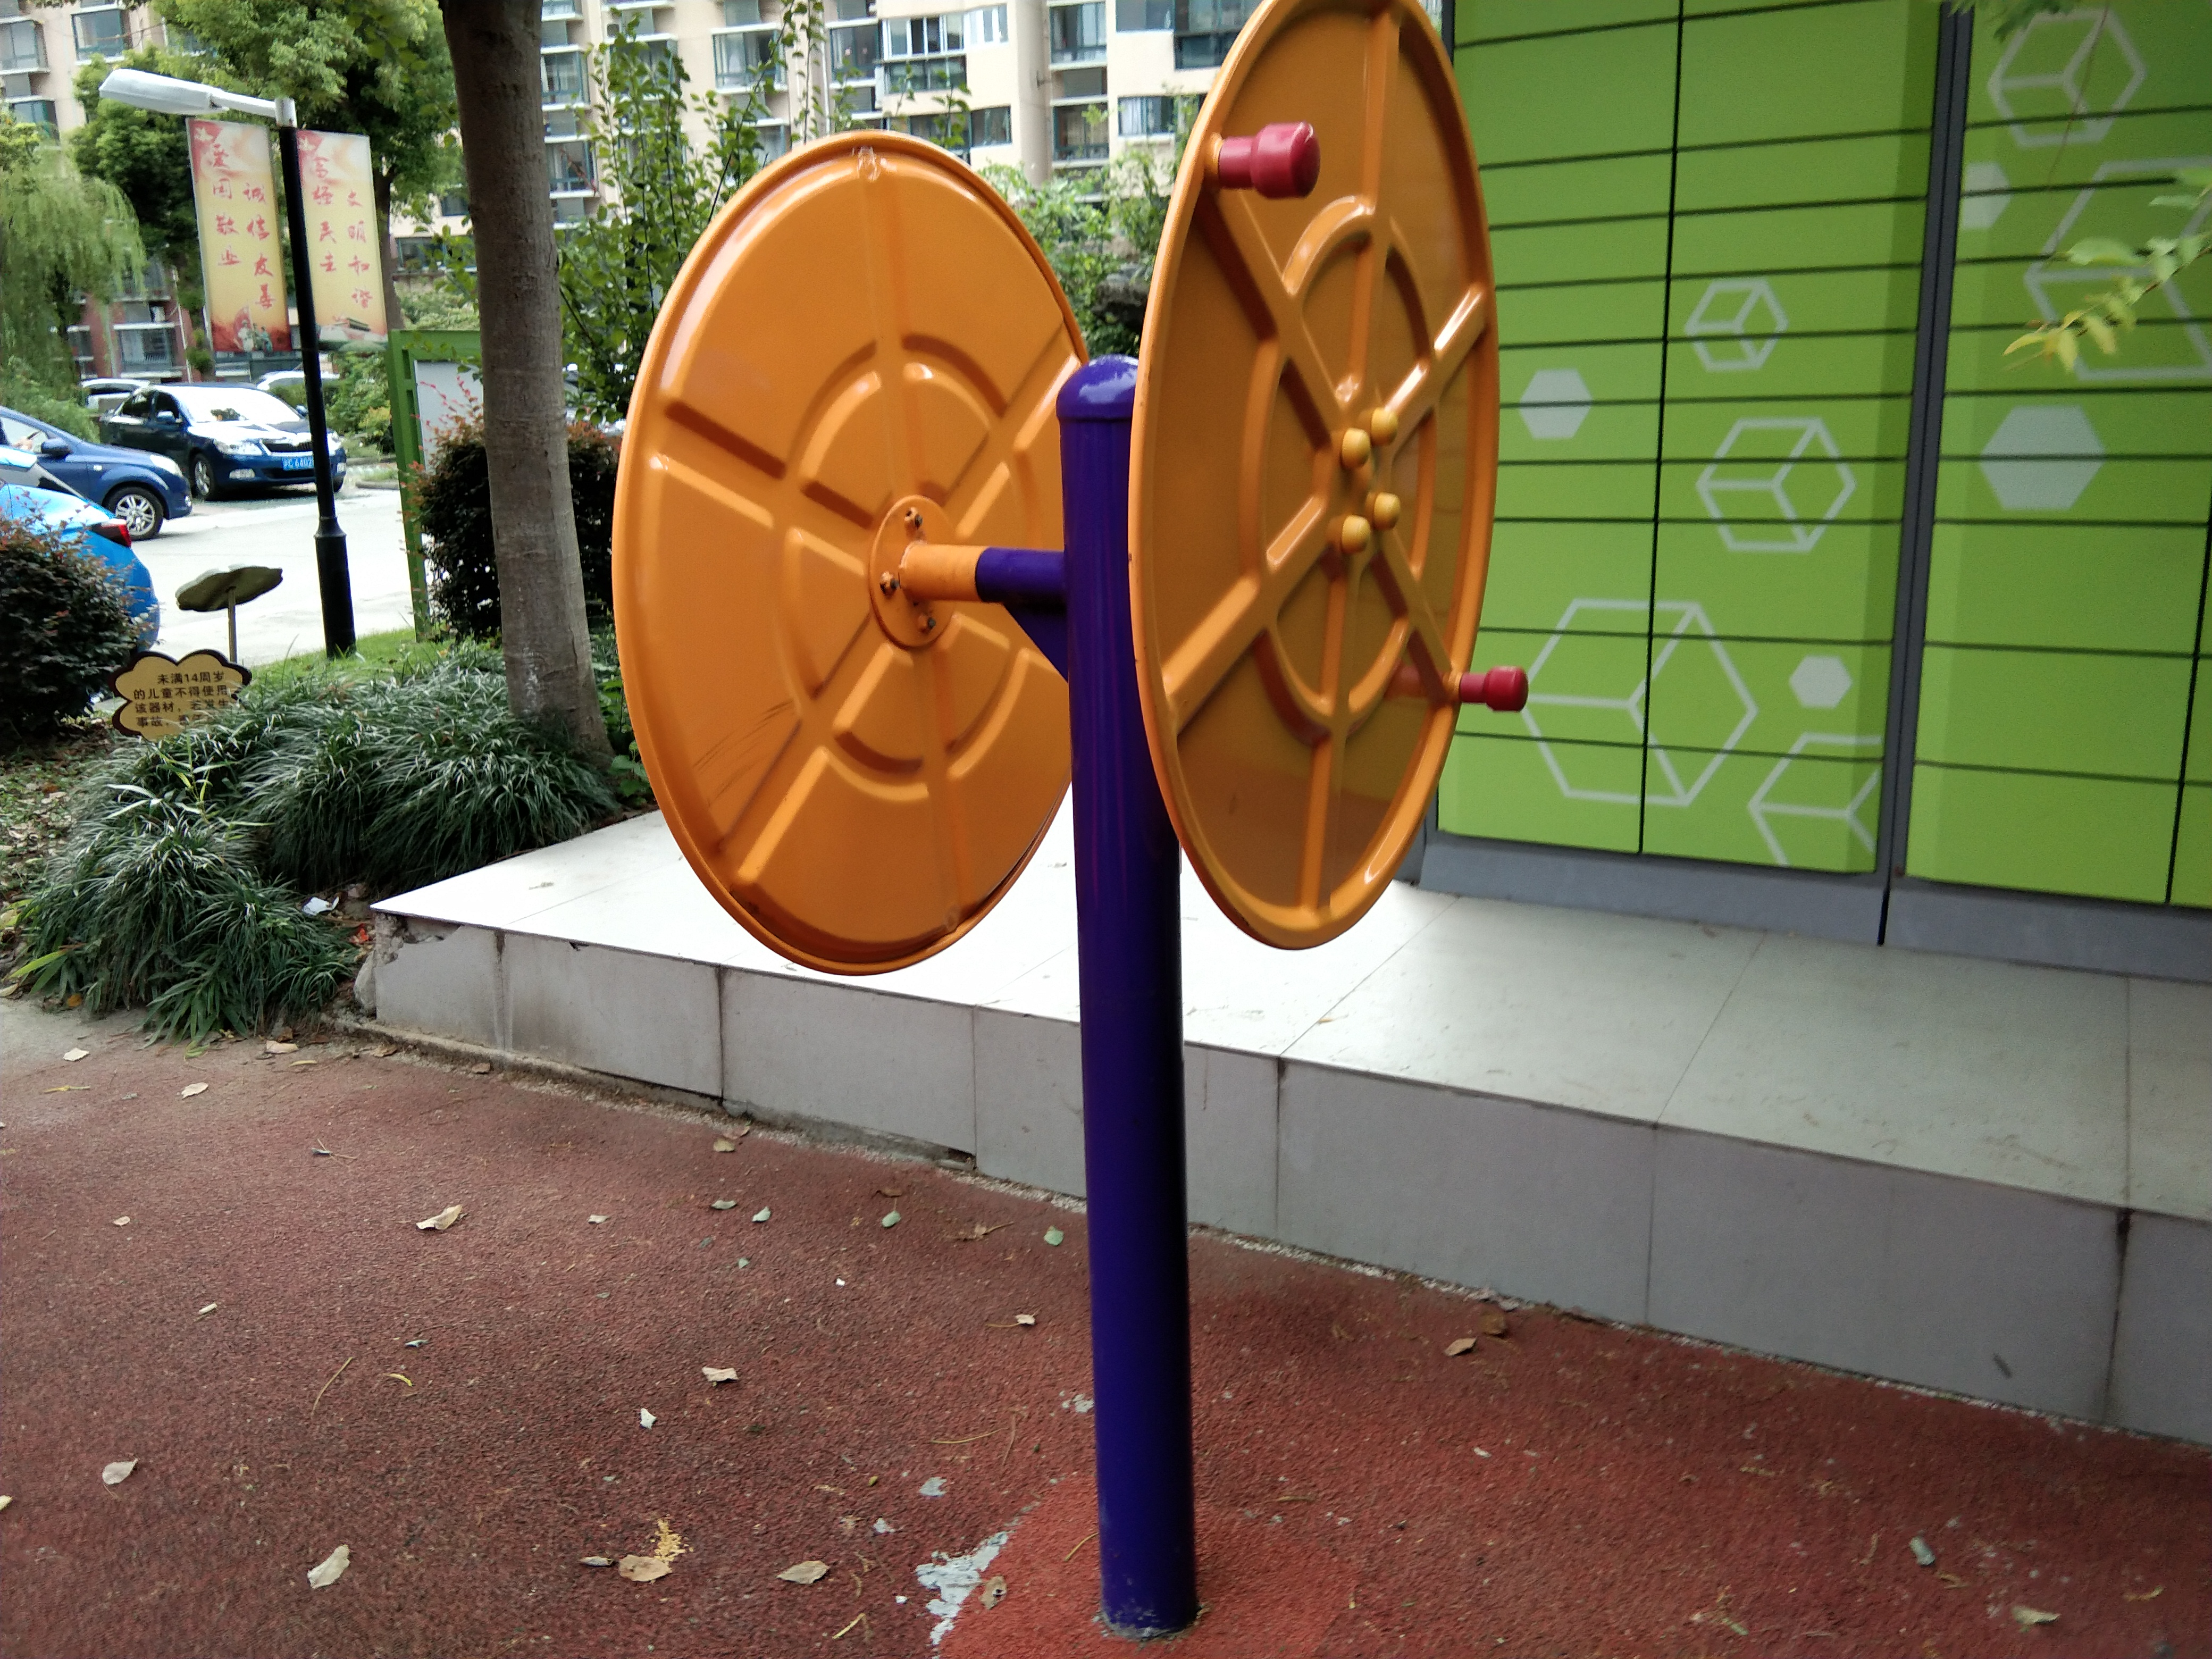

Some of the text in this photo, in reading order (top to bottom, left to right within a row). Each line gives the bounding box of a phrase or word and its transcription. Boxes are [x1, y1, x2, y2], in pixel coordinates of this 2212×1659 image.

[157, 671, 224, 685] 未满14周岁
[133, 684, 228, 700] 的儿童不得使用
